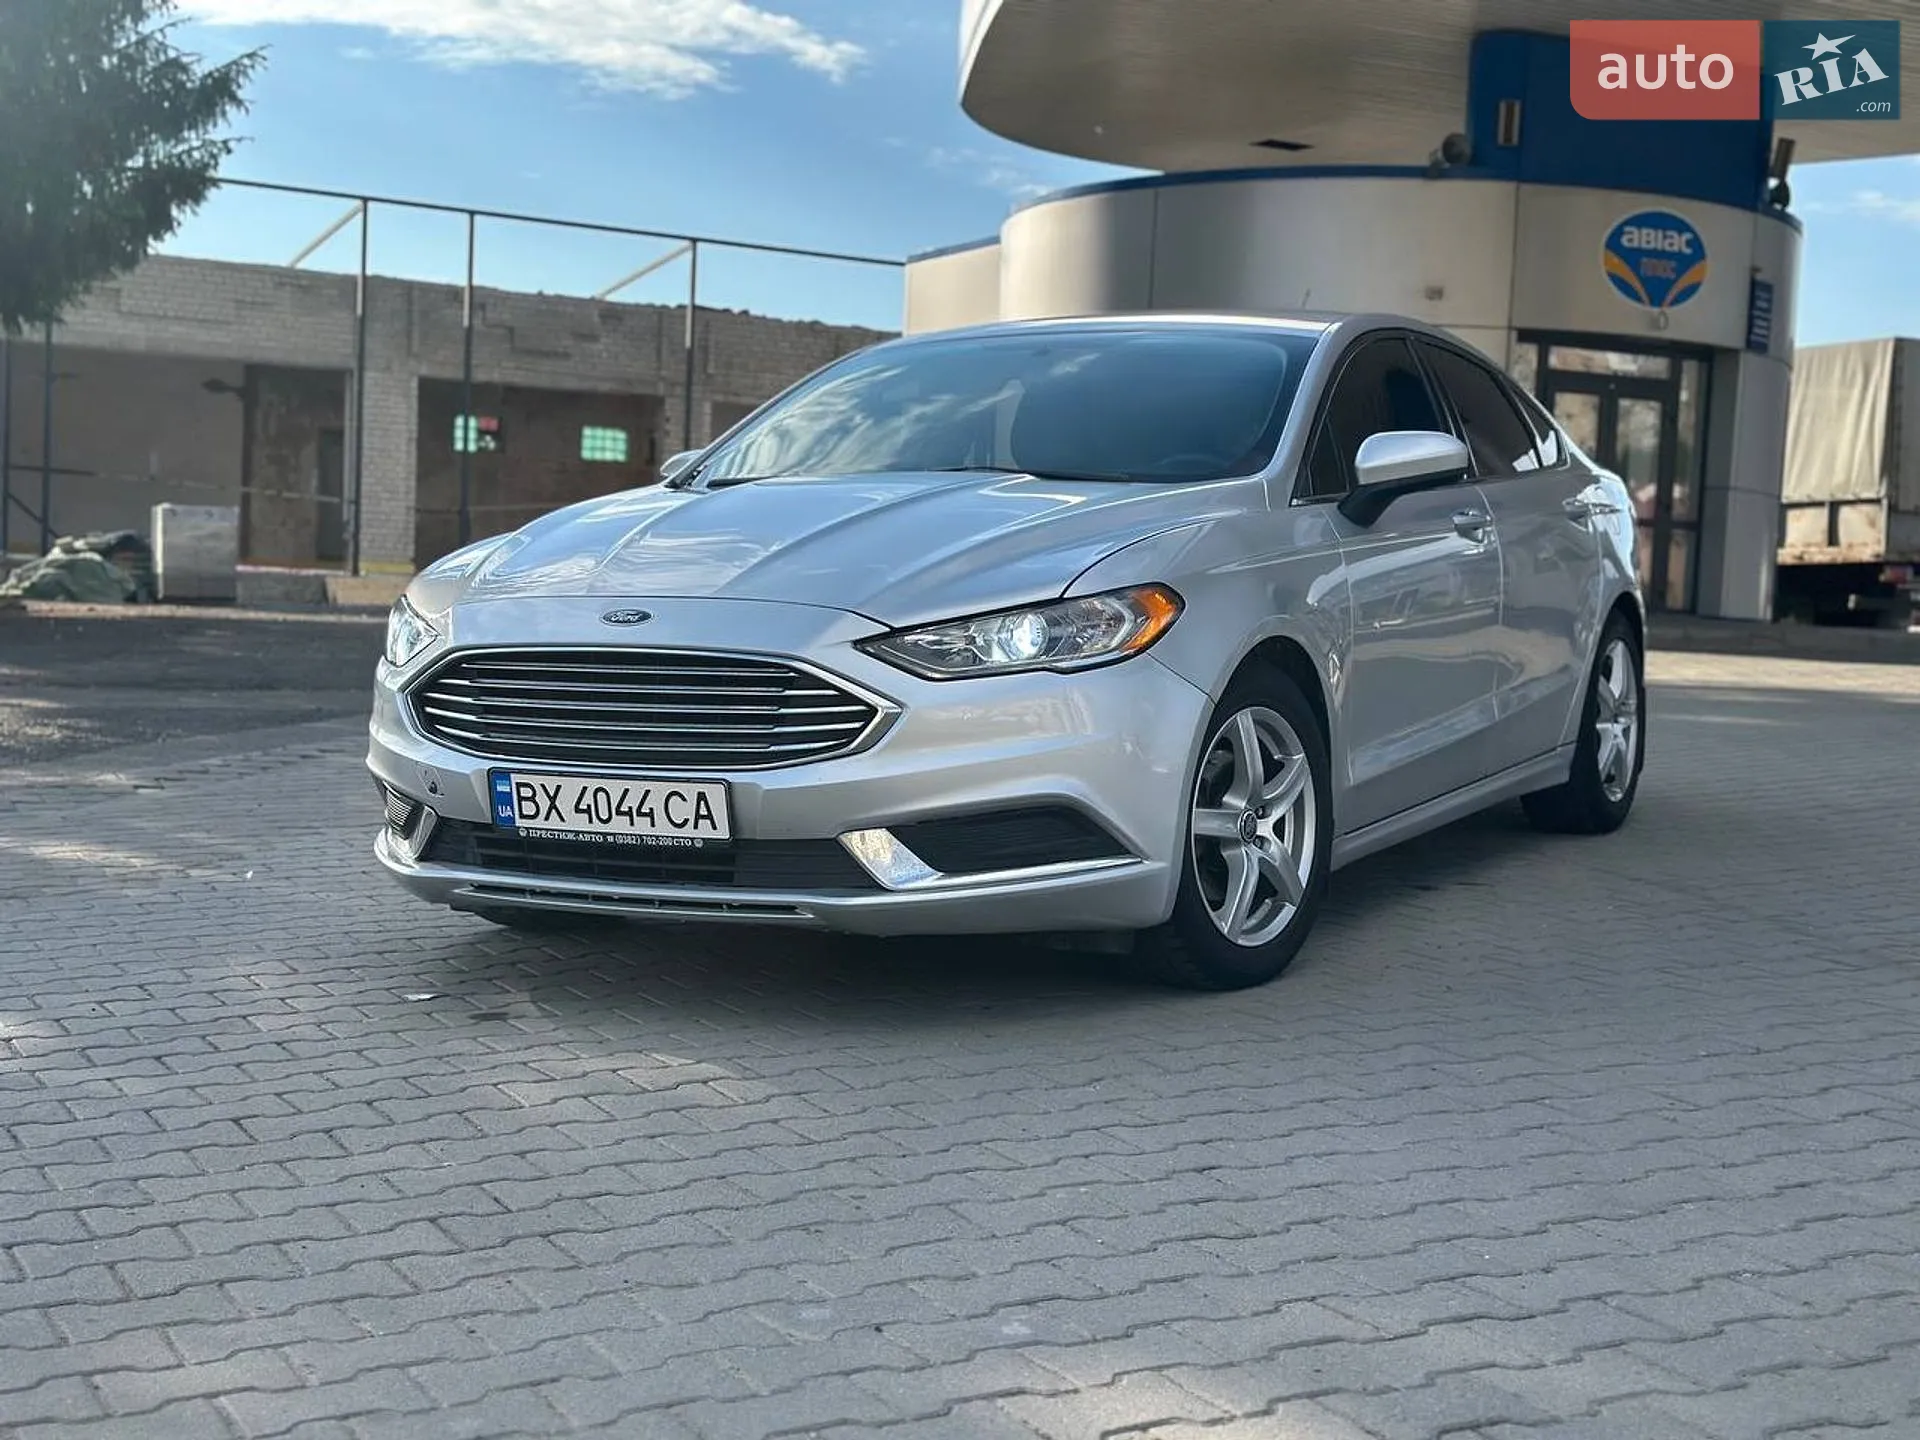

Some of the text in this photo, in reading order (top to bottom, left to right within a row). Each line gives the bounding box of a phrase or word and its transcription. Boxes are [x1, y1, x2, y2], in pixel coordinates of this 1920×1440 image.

[609, 610, 643, 621] Ford
[498, 805, 513, 817] UA
[515, 781, 718, 831] BX 4044 CA
